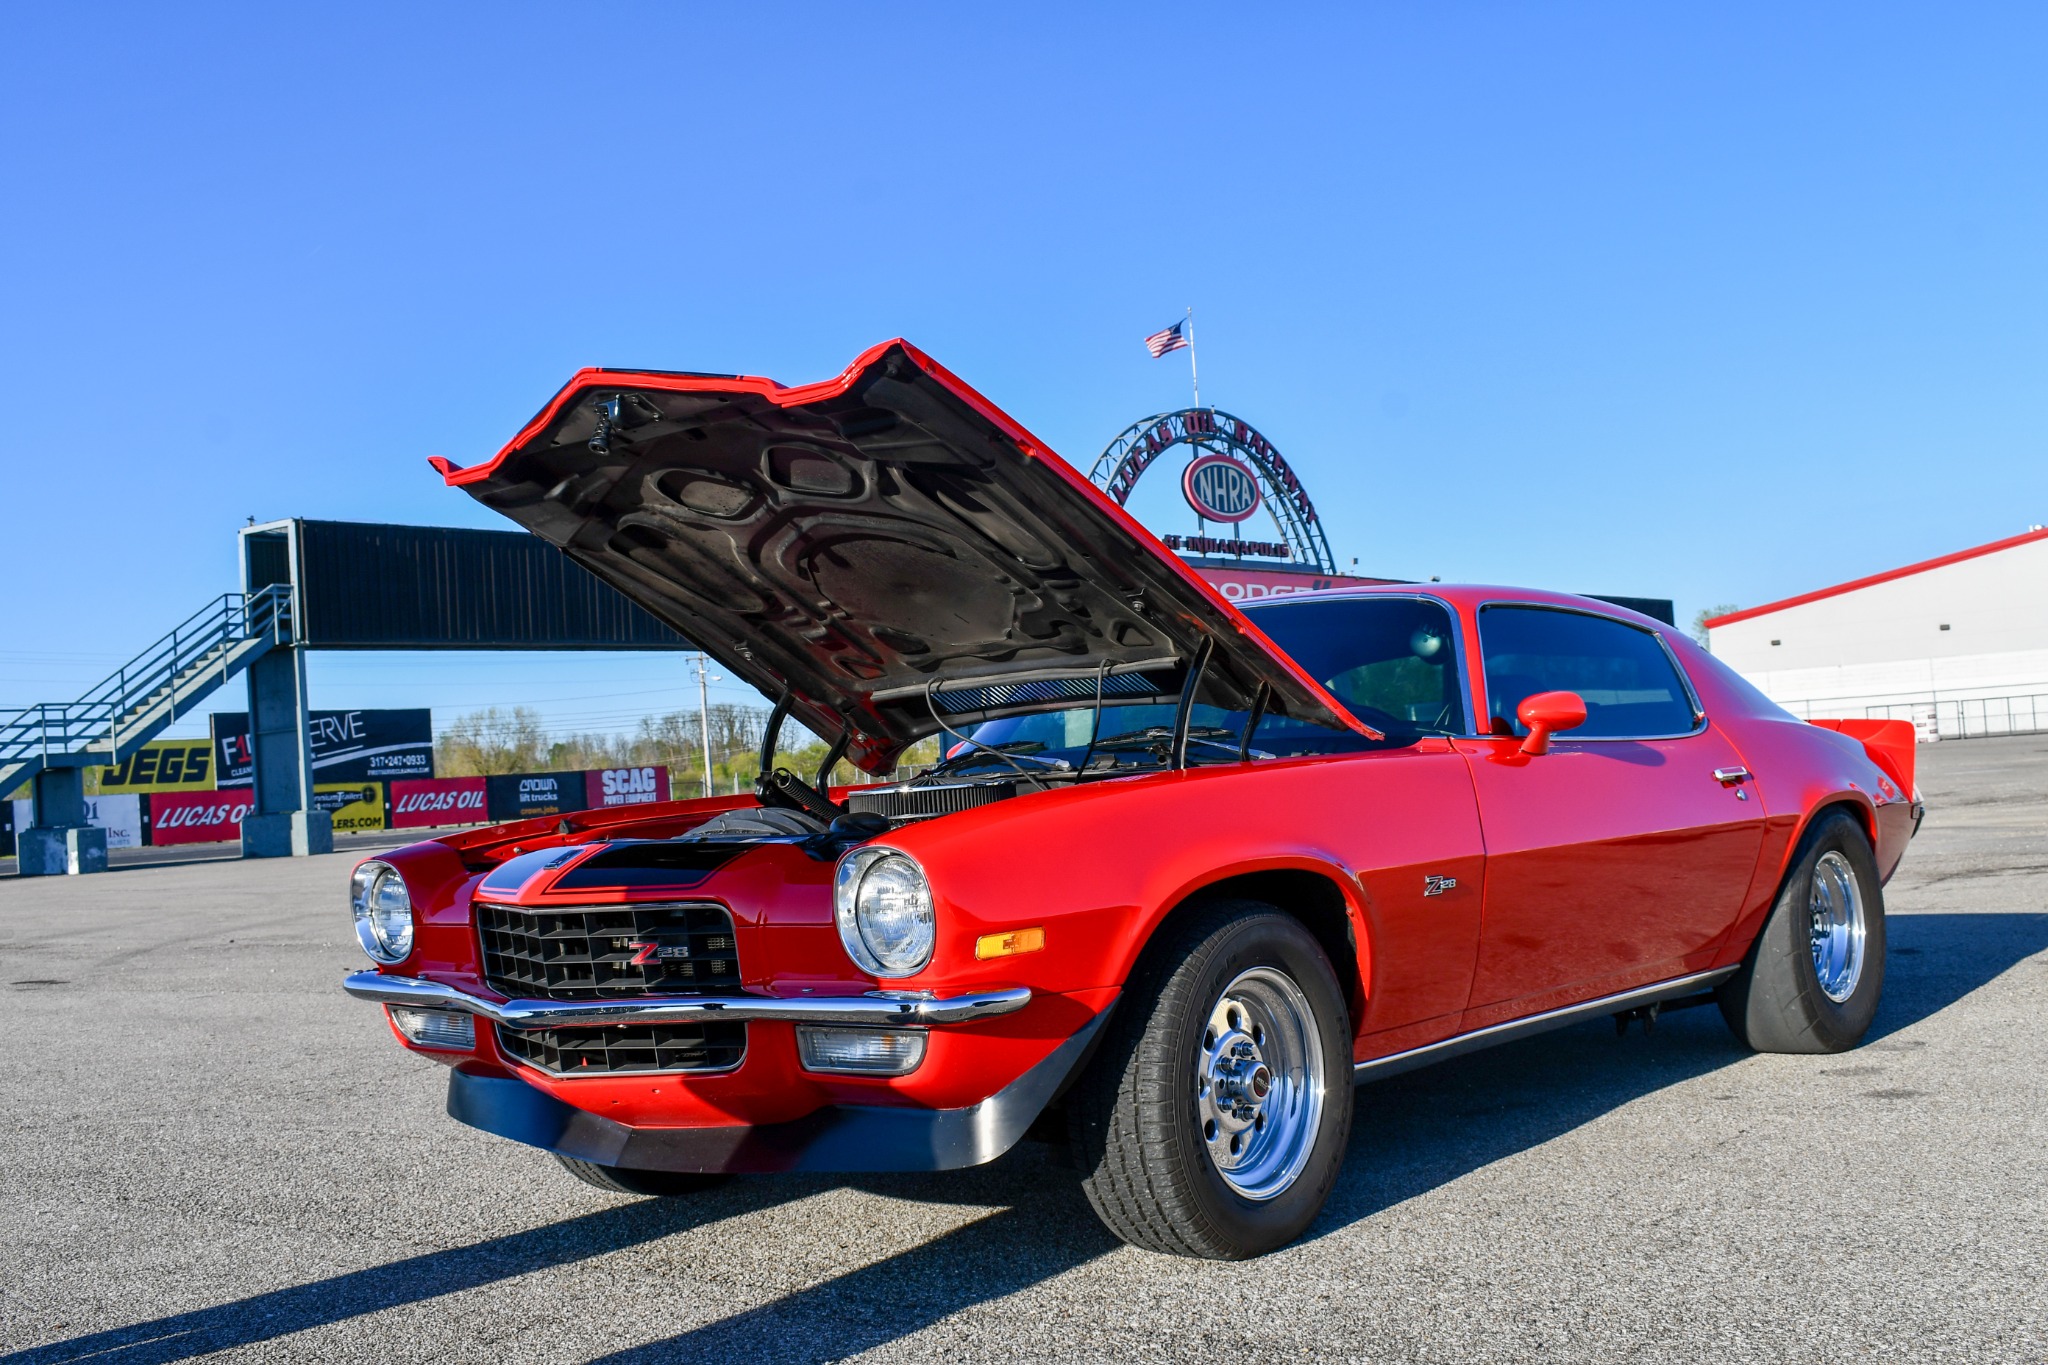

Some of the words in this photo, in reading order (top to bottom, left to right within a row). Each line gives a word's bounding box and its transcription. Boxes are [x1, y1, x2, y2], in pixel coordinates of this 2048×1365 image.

[1111, 422, 1173, 506] LUCAS
[1184, 411, 1219, 435] OIL
[1235, 420, 1318, 524] RACEWAY
[1200, 464, 1251, 512] NHRA
[1162, 534, 1182, 550] AT
[1186, 536, 1289, 557] INDIANAPOLIS
[1208, 582, 1314, 600] ODG
[309, 711, 366, 747] ERVE
[102, 747, 211, 785] JEGS
[602, 768, 656, 795] SCAG
[395, 791, 458, 813] LUCAS
[457, 790, 484, 809] OIL
[520, 794, 531, 803] lift
[532, 793, 558, 802] trucks
[604, 795, 625, 805] POWER
[625, 792, 656, 803] EQUIPMENT
[156, 804, 230, 829] LUCAS
[332, 817, 382, 828] LERS.COM
[1424, 875, 1456, 897] Z28
[628, 941, 689, 966] Z28
